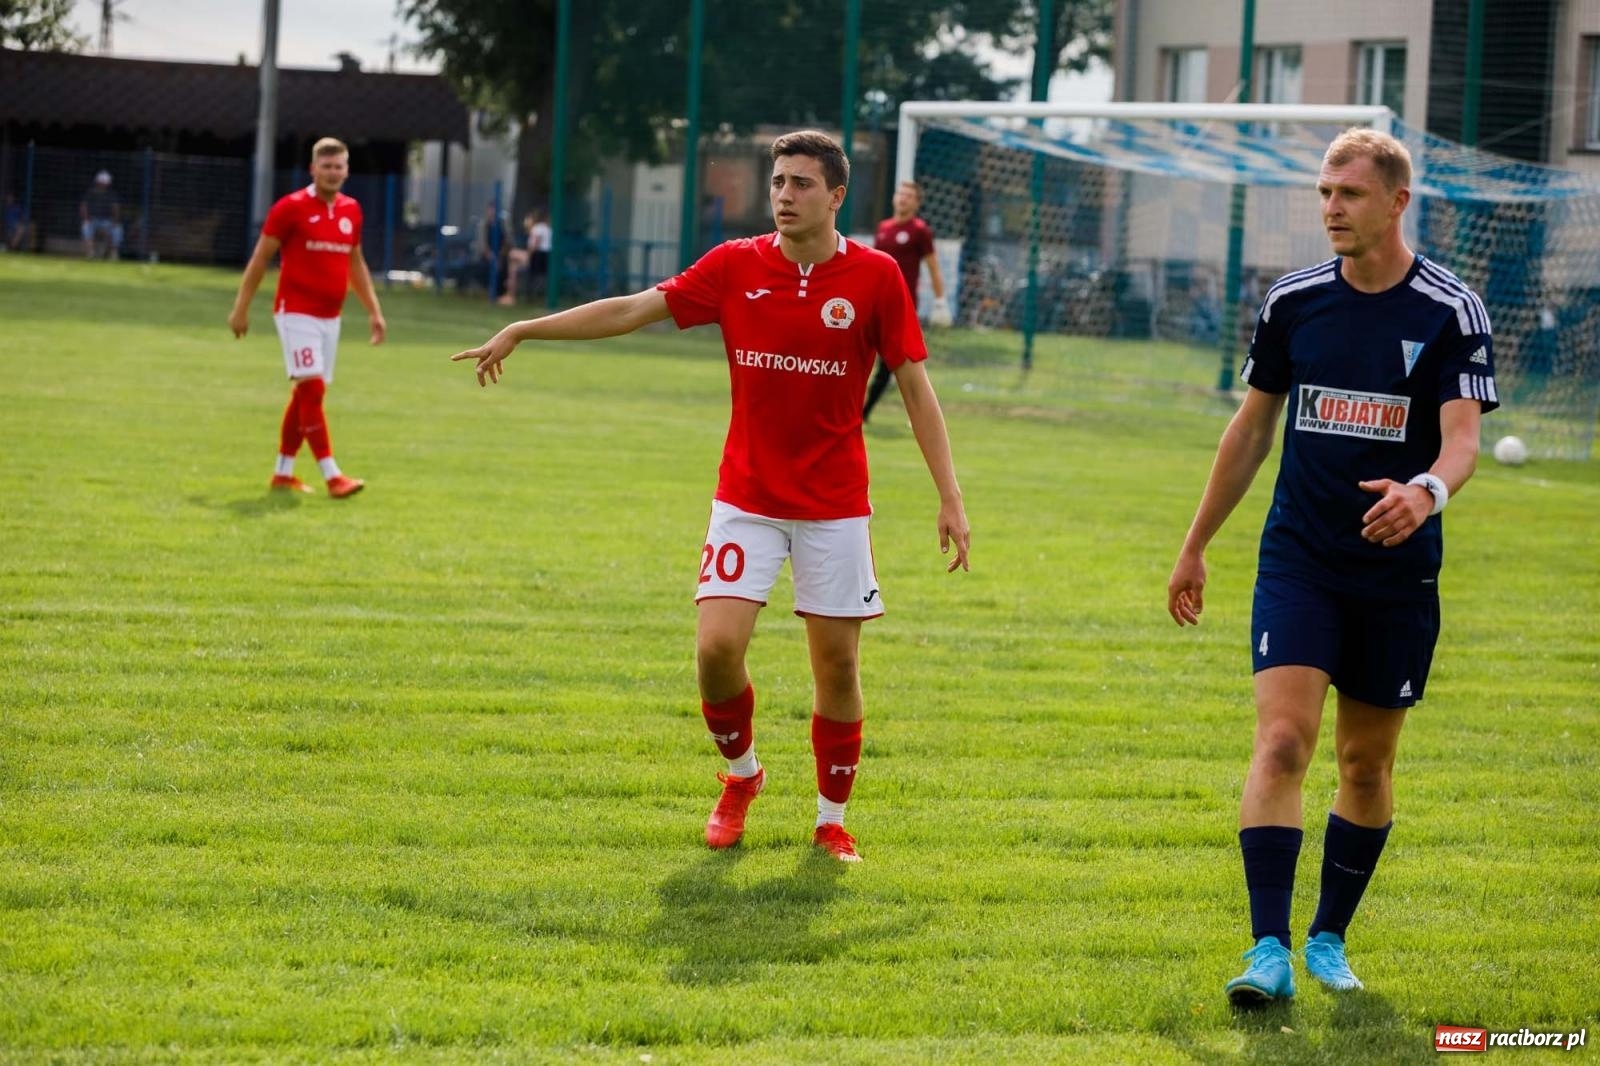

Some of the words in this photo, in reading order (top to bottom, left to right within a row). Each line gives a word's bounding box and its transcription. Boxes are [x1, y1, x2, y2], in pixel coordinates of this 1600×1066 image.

[293, 347, 314, 368] 18
[1300, 387, 1407, 430] KUBJATKO
[1299, 418, 1402, 439] WWW.KUBJATKO.CZ
[698, 542, 745, 584] 20
[1258, 631, 1269, 657] 4
